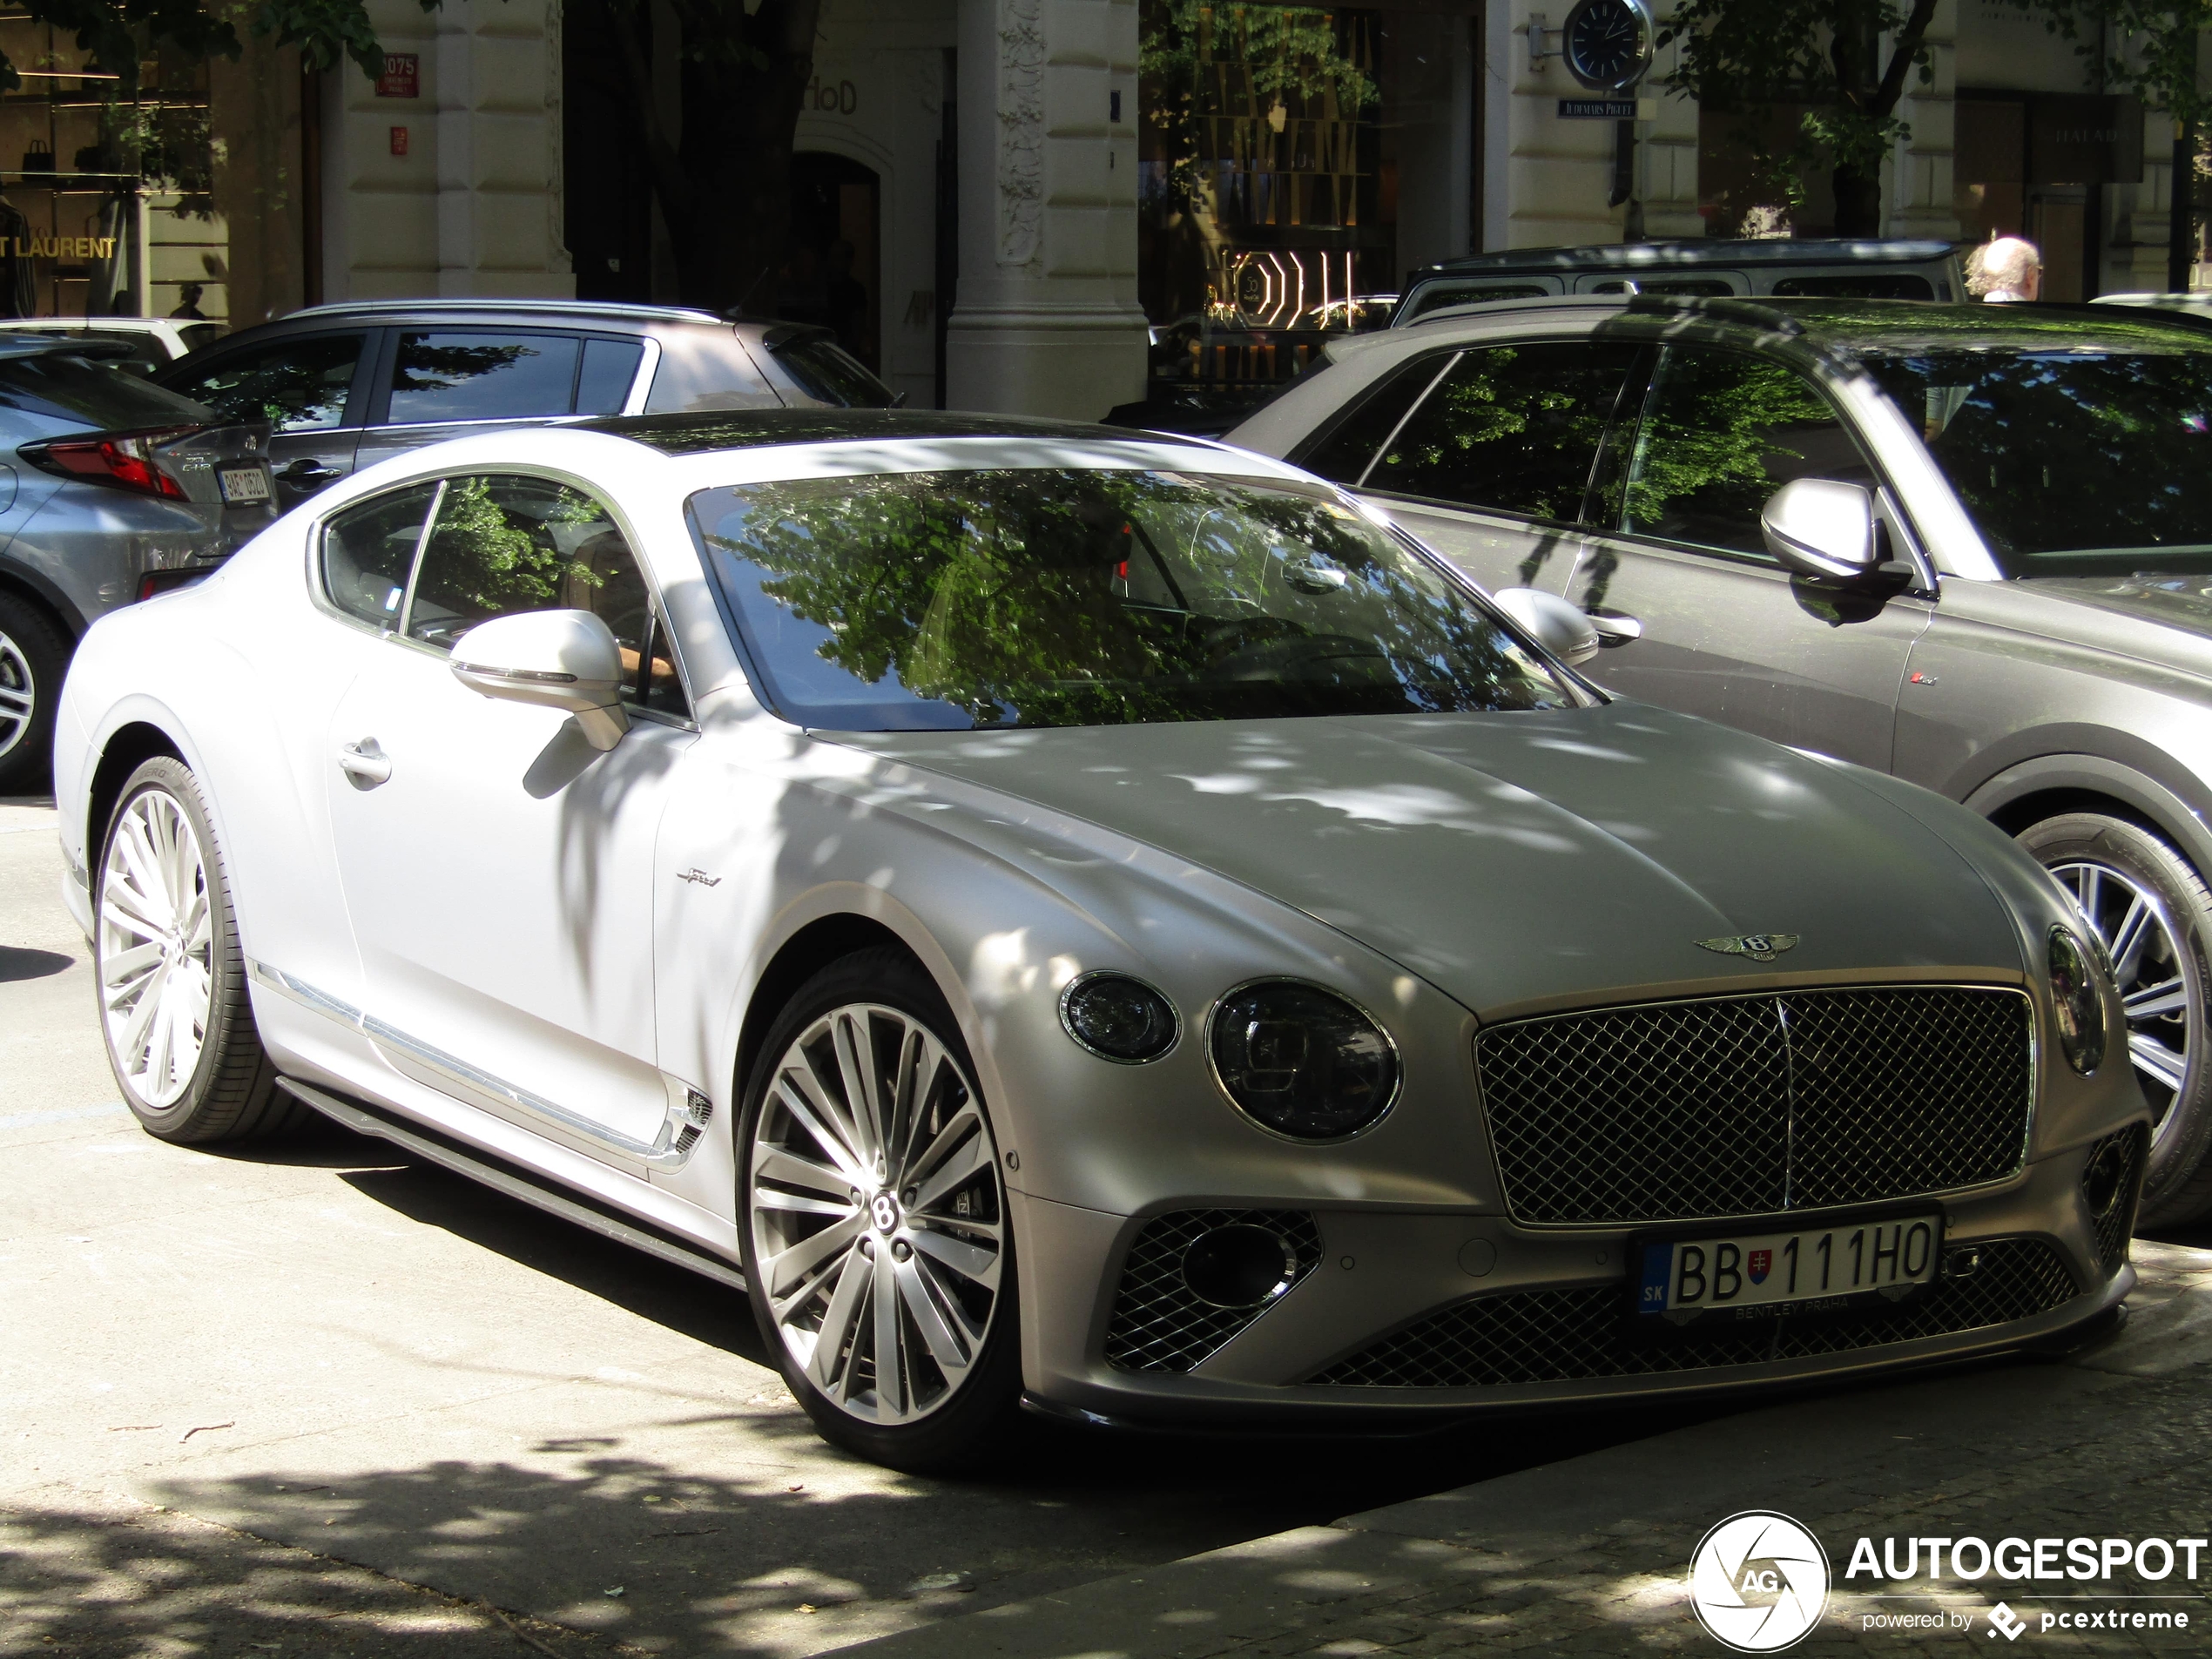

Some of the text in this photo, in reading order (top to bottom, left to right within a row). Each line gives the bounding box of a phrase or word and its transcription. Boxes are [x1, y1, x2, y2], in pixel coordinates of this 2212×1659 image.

[1606, 103, 1632, 115] PIGUET
[15, 236, 117, 259] LAURENT
[1676, 1221, 1931, 1303] BB 111HO
[1643, 1285, 1663, 1302] SK
[1736, 1297, 1848, 1319] BENTLEY PRAHA
